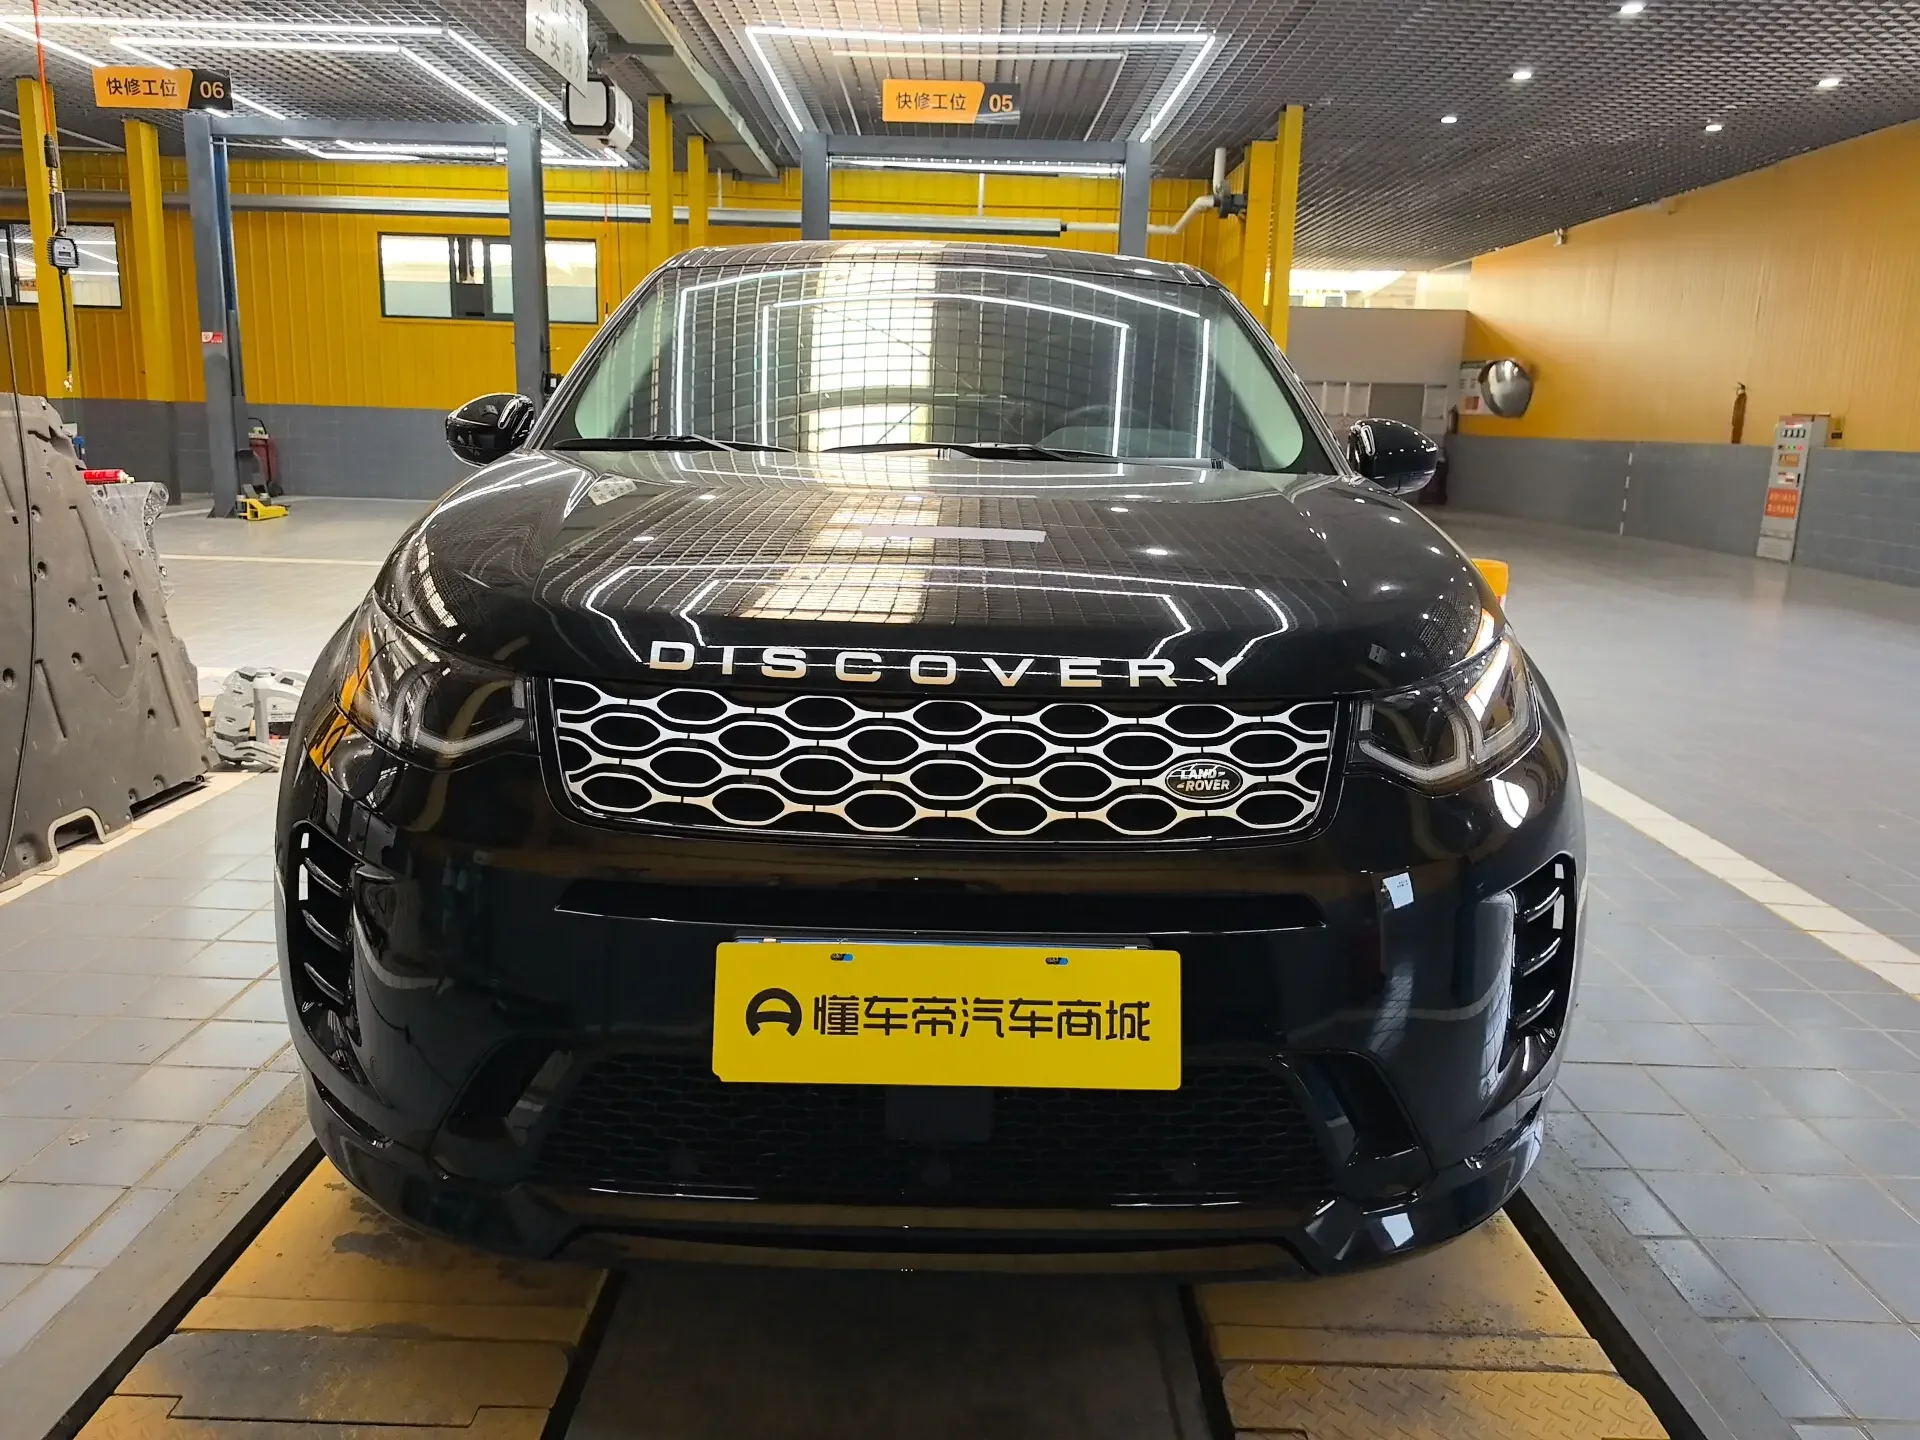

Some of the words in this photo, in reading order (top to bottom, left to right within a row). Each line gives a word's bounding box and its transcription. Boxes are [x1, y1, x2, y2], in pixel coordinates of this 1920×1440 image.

[106, 77, 177, 97] 快修工位
[200, 81, 225, 99] 06
[895, 92, 967, 111] 快修工位
[989, 94, 1014, 113] 05
[649, 640, 1245, 688] DISCOVERY
[1180, 768, 1218, 780] LAND
[1185, 779, 1231, 792] ROVER
[813, 993, 1151, 1042] 懂车帝汽车商城
